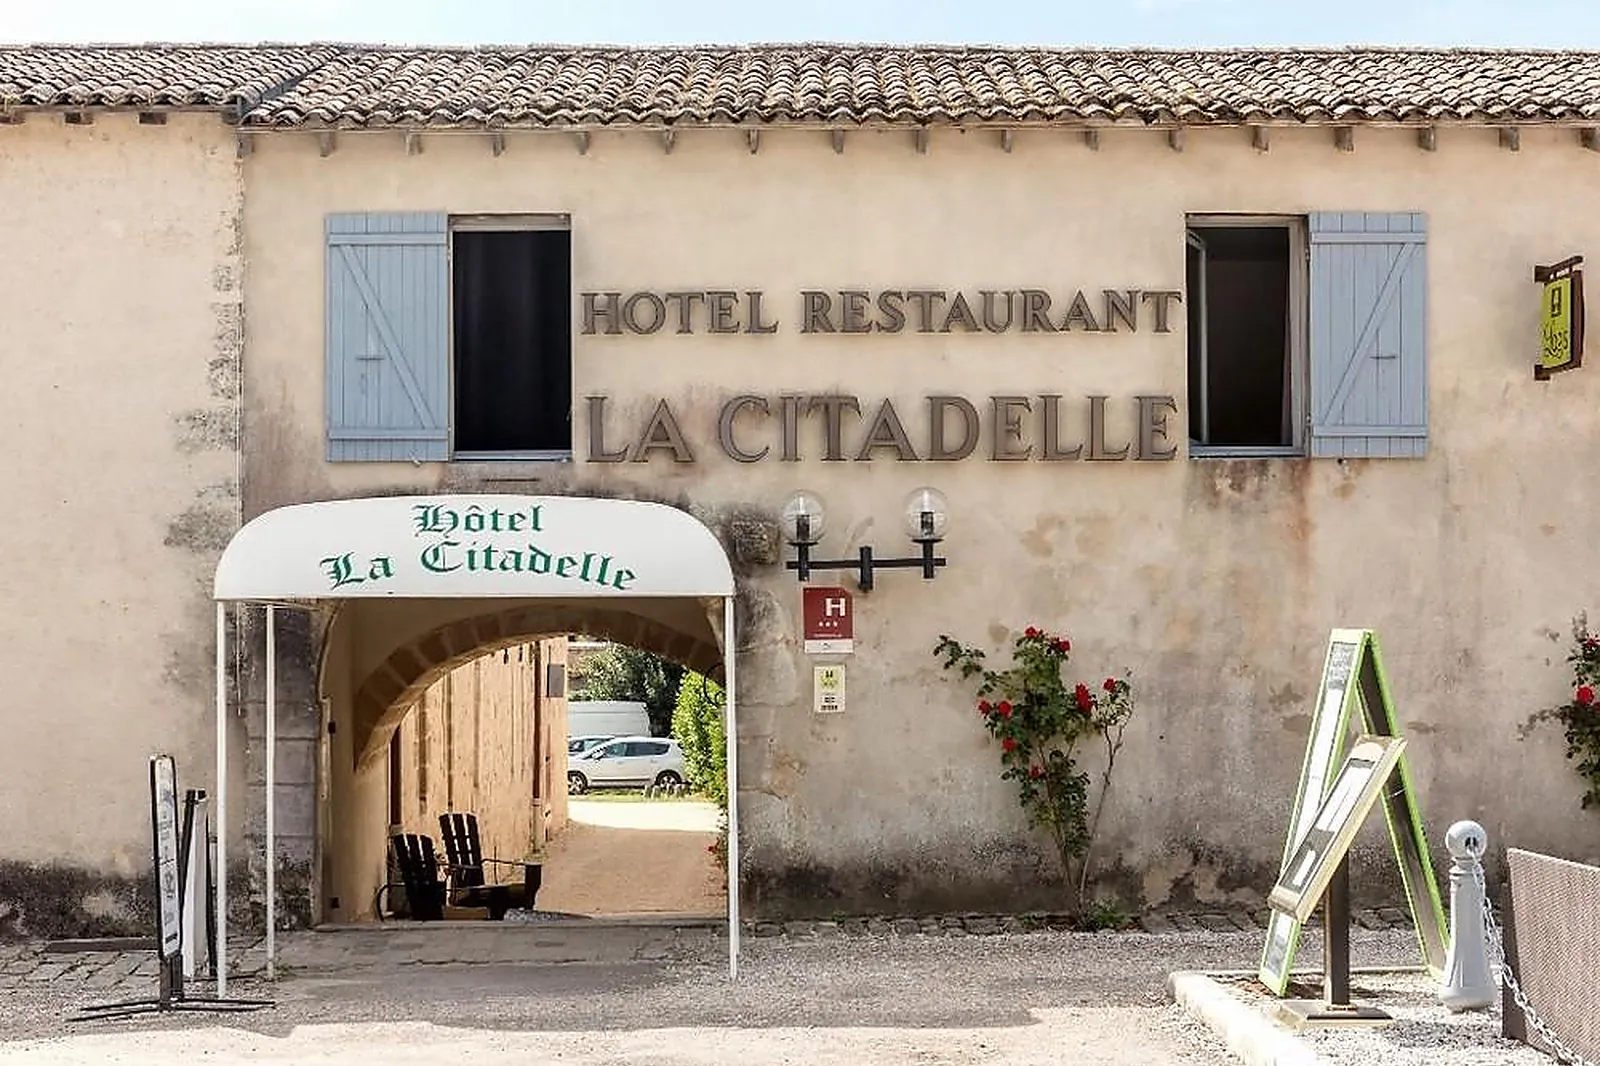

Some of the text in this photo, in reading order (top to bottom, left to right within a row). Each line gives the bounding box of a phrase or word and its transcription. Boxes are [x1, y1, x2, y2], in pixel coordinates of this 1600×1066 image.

[580, 290, 1182, 334] HOTEL RESTAURANT
[585, 396, 1179, 463] LA CITADELLE
[413, 504, 543, 537] Hôtel
[320, 540, 637, 591] La Citadelle
[825, 597, 846, 617] H
